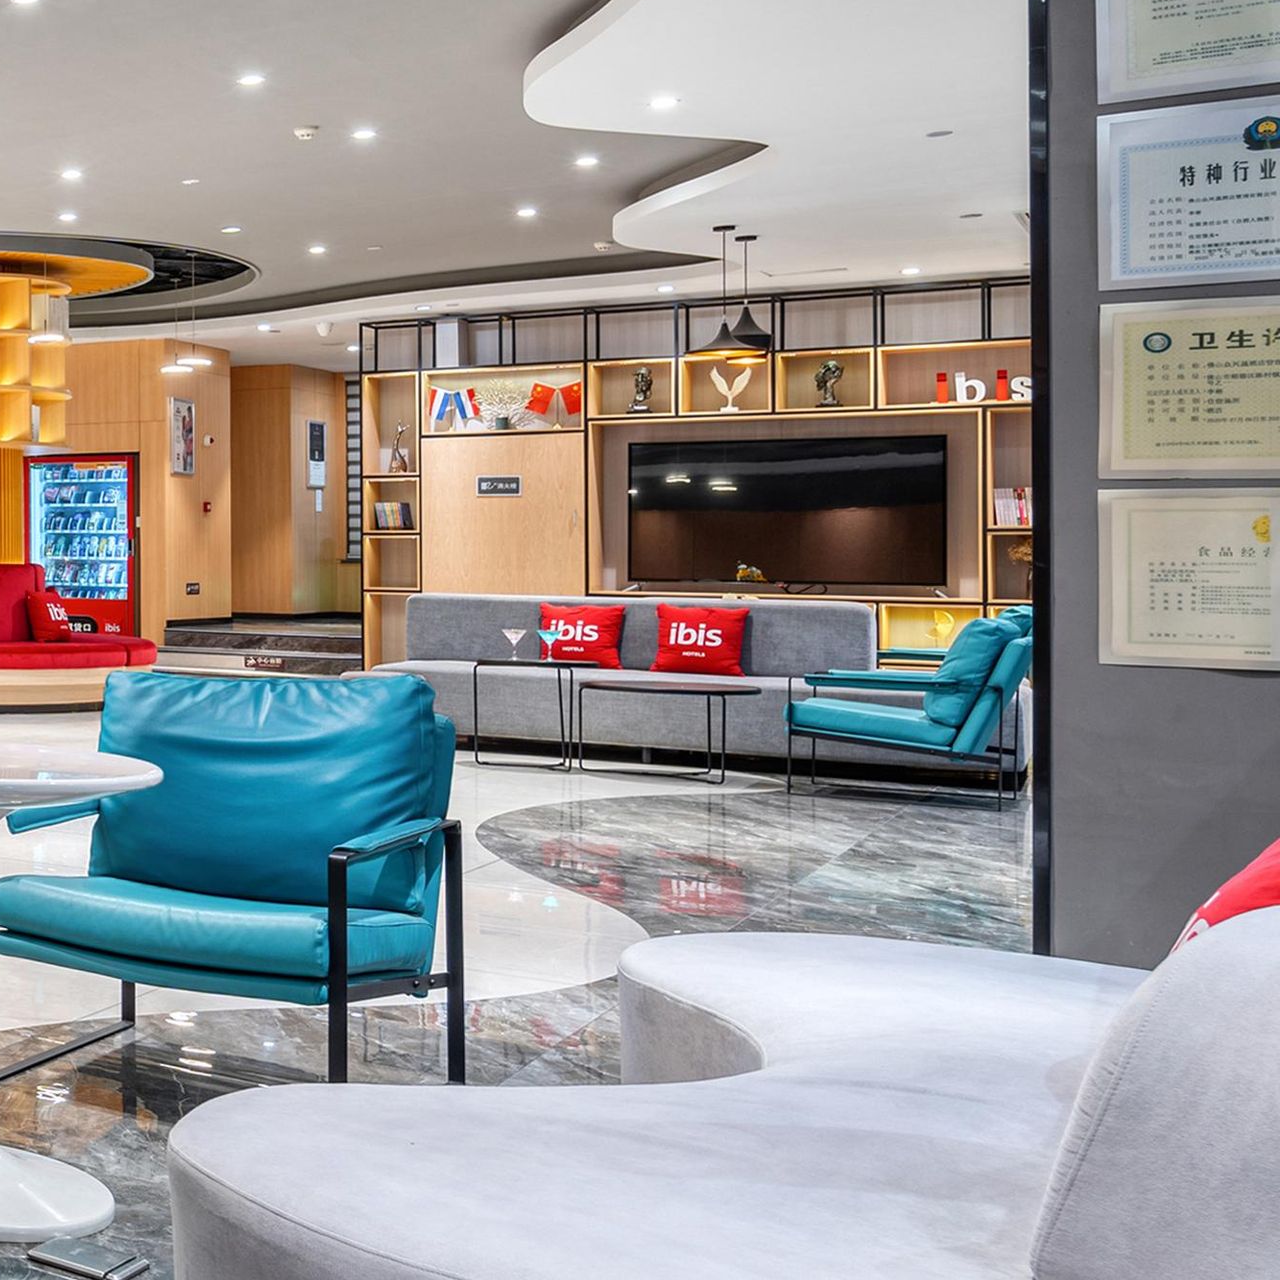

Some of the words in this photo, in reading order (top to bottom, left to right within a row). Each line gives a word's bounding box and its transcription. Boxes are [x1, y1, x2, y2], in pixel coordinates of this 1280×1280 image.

[1179, 158, 1277, 187] 特种行业
[936, 370, 1032, 404] ibis
[105, 623, 121, 632] ibis
[548, 619, 599, 641] ibis
[669, 622, 722, 647] ibis
